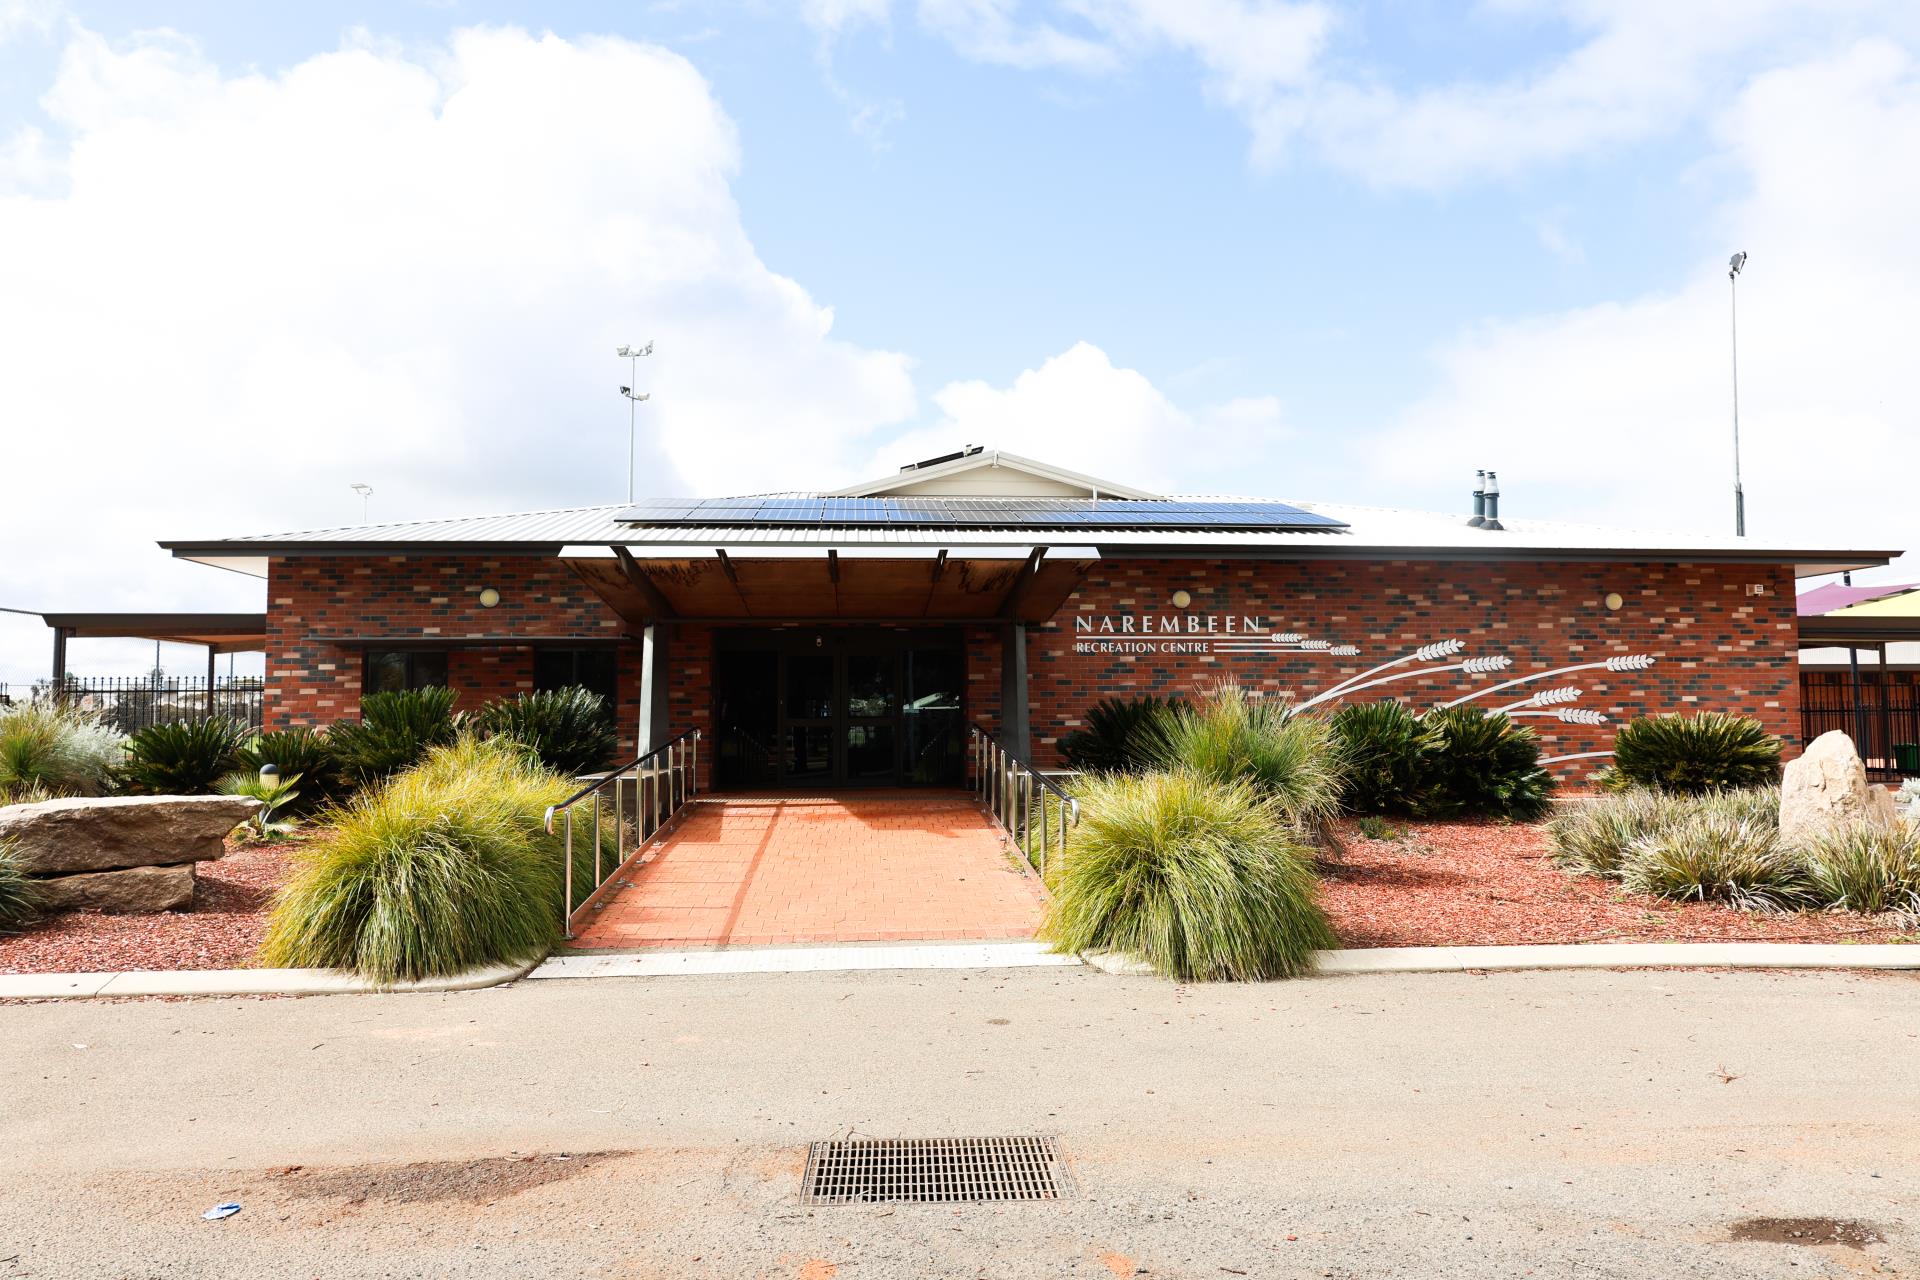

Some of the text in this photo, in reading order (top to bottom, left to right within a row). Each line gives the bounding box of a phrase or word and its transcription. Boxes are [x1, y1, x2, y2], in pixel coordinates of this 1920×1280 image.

[1076, 615, 1259, 633] NAREMBEEN
[1076, 642, 1209, 653] RECREATION CENTRE
